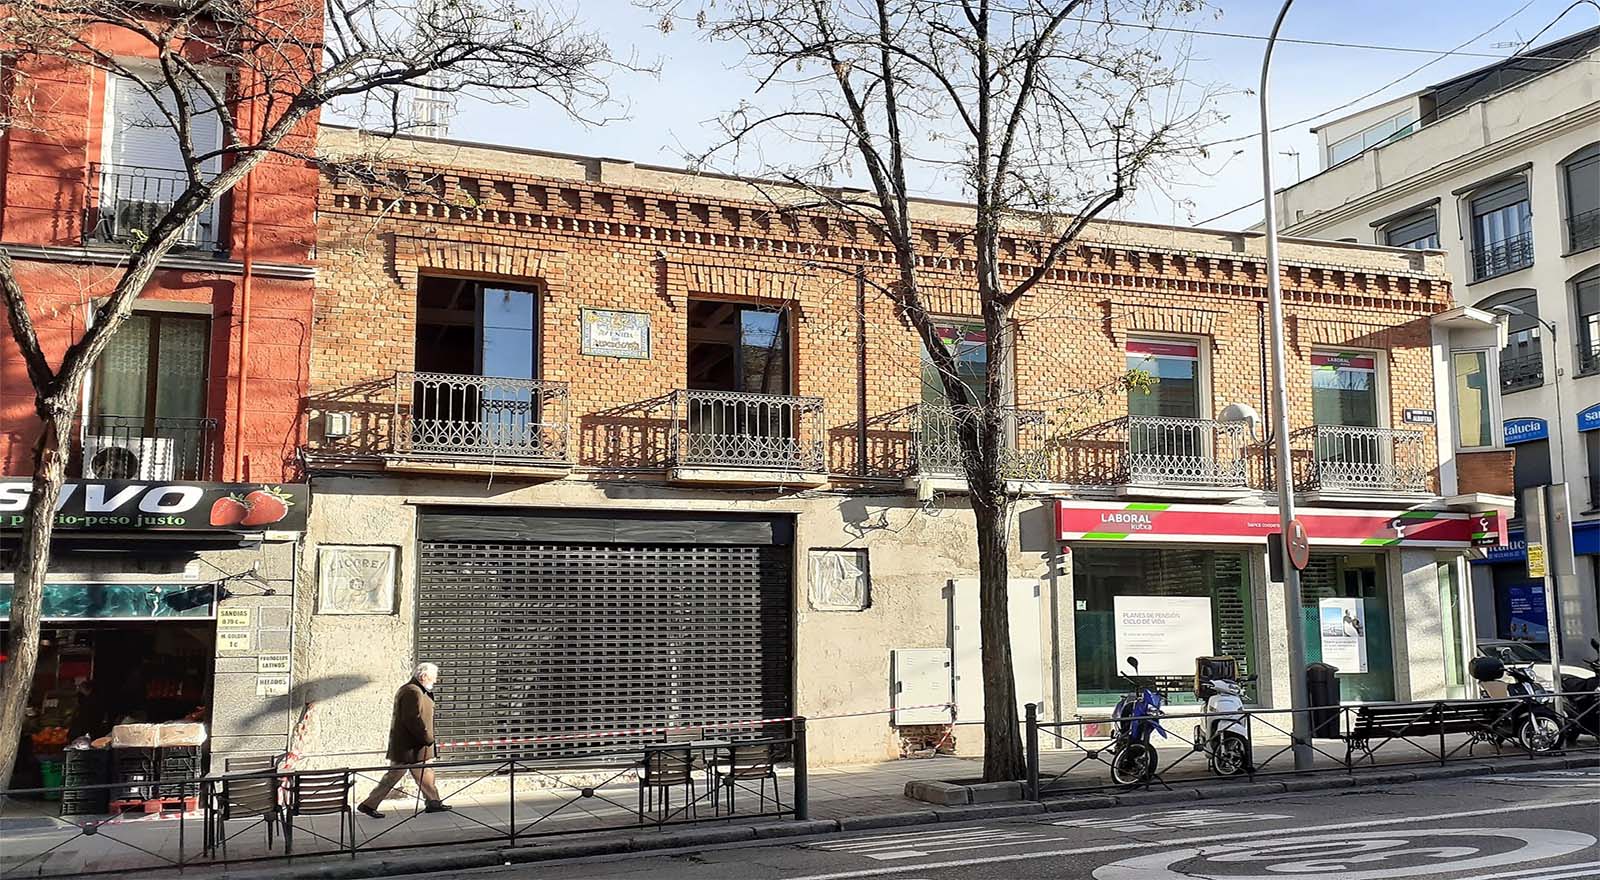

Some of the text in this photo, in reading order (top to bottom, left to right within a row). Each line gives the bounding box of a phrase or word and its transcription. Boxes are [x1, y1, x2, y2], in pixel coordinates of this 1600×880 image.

[11, 515, 130, 527] pio-peso
[134, 515, 186, 527] justo
[1101, 512, 1151, 524] LABORAL
